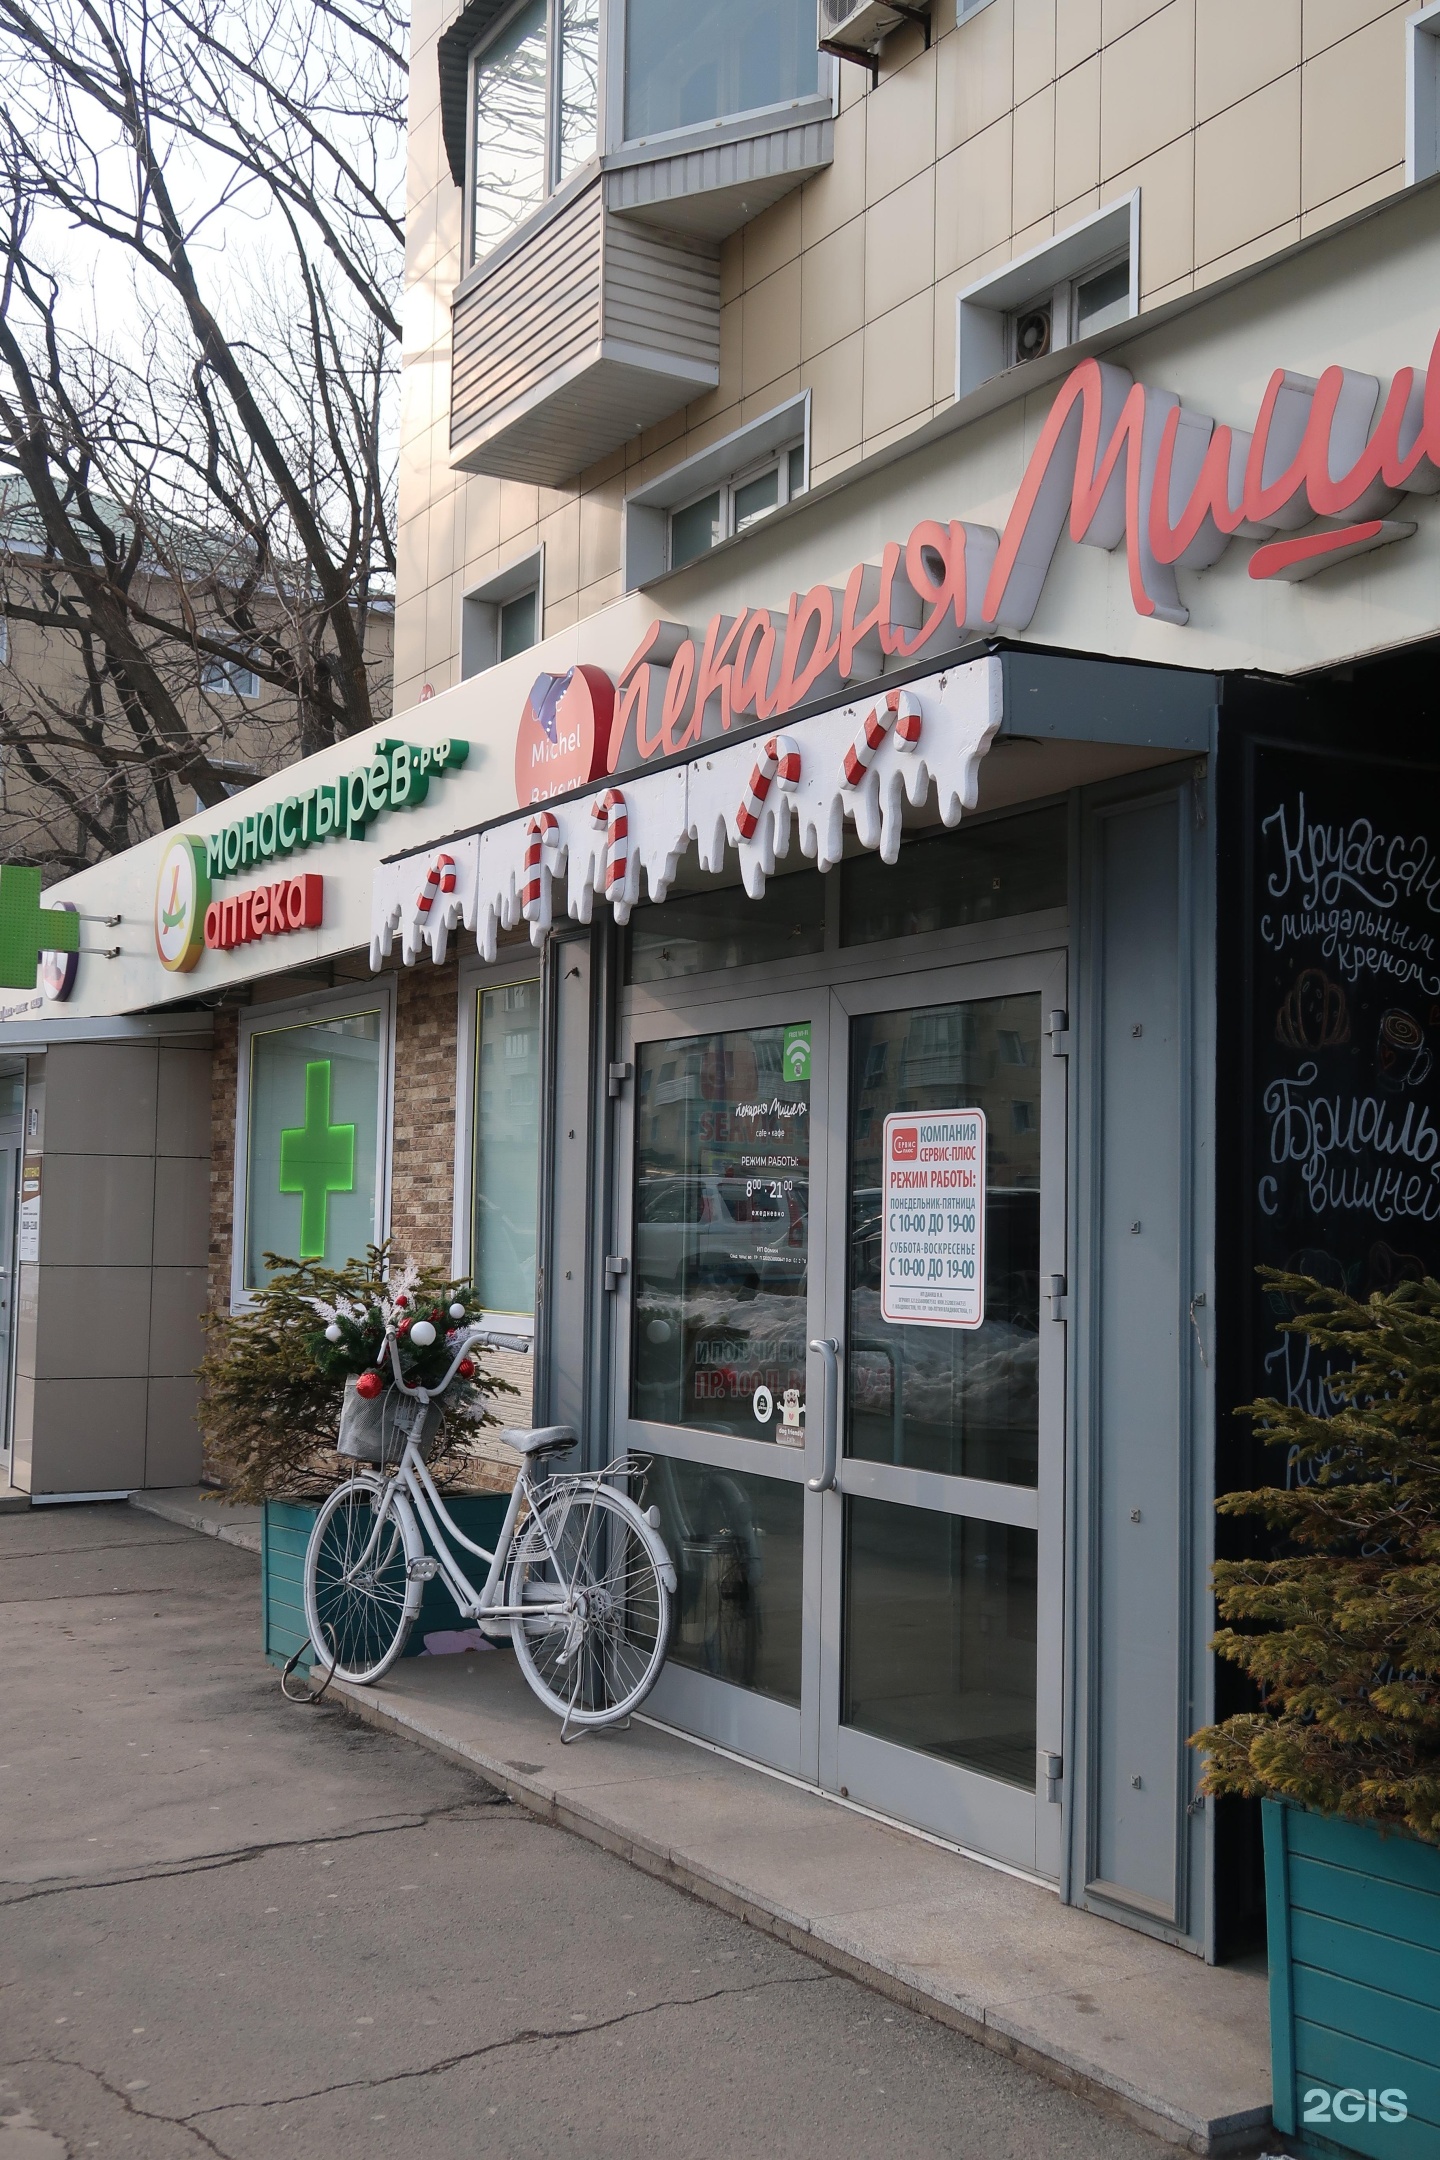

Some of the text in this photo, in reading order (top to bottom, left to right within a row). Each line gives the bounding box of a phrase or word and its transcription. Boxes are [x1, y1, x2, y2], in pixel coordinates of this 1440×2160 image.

[531, 723, 581, 768] Michel
[203, 875, 313, 950] аптека
[1274, 909, 1434, 957] миндальным
[1337, 943, 1440, 995] кремом
[1263, 1061, 1438, 1181] Бриошь
[920, 1123, 977, 1143] КОМПАНИЯ
[741, 1156, 799, 1166] РЕЖИМ РАБОТЫ:
[920, 1145, 977, 1162] СЕРВИС-ПЛЮС
[890, 1169, 977, 1189] РЕЖИМ РАБОТЫ:
[751, 1210, 785, 1218] ежедневно
[890, 1197, 976, 1211] ПОНЕДЕЛЬНИК-ПЯТНИЦА
[889, 1213, 976, 1236] С 10-00 ДО 19-00
[889, 1242, 976, 1256] СУББОТА-ВОСКРЕСЕНЬЕ
[889, 1257, 975, 1281] С 10-00 ДО 19-00
